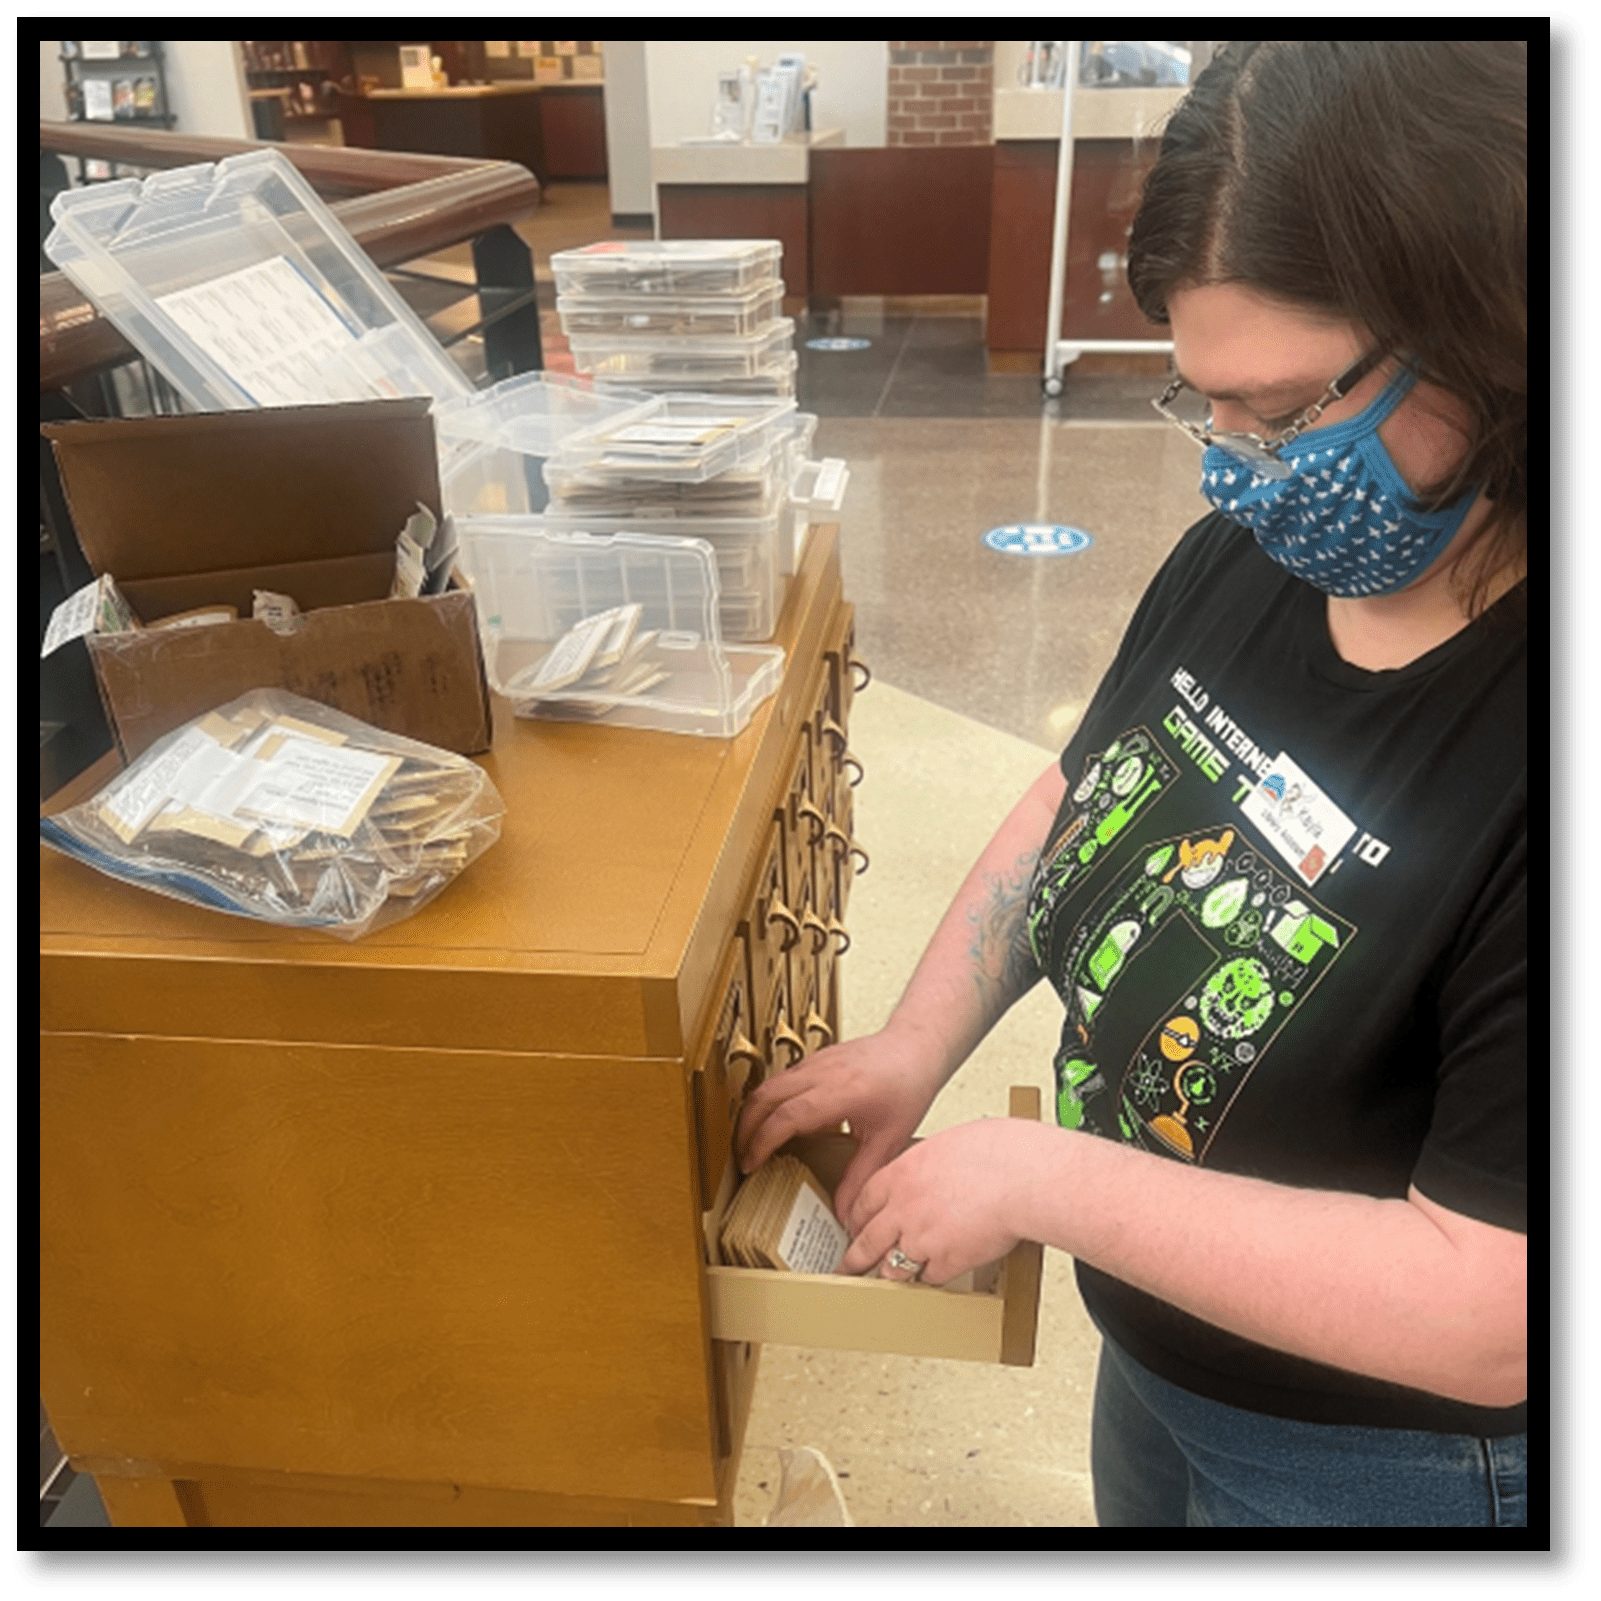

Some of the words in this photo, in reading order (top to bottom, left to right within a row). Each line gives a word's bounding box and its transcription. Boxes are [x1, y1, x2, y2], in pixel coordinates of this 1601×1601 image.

[1163, 704, 1232, 783] GAME
[1170, 666, 1209, 713] HELLO
[1204, 705, 1273, 779] INTERNE
